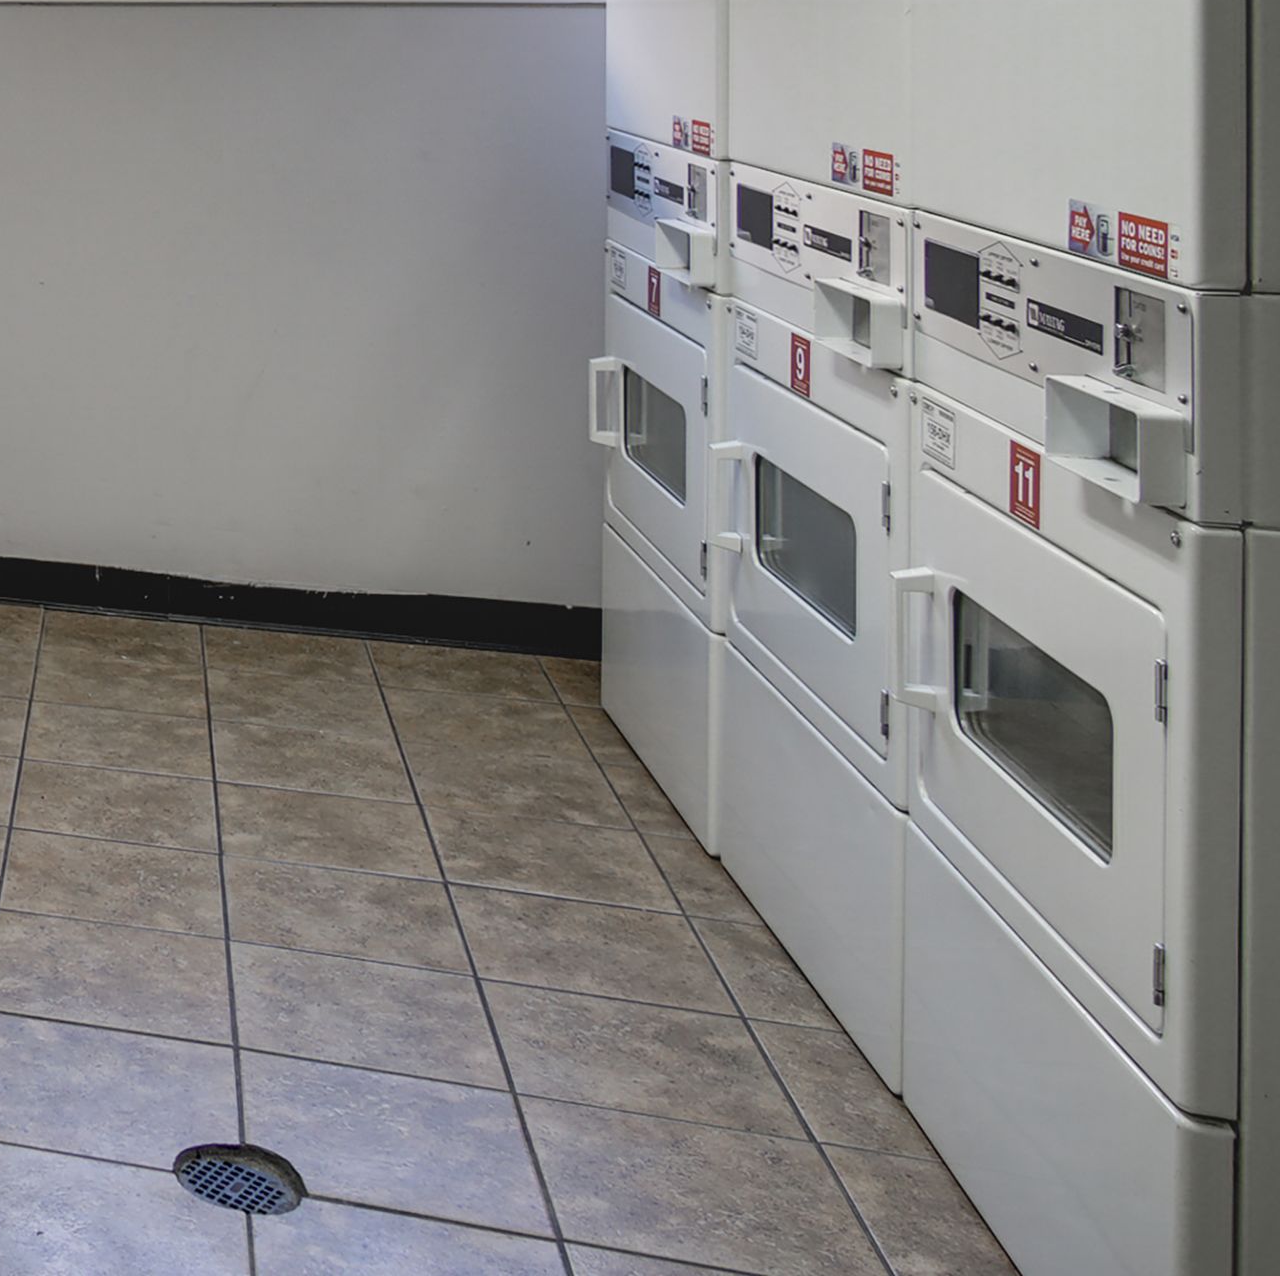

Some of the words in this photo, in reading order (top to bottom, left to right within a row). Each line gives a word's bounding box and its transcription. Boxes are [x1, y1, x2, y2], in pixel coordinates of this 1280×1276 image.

[1071, 224, 1091, 242] HERE
[1074, 214, 1087, 228] PAY
[1120, 218, 1136, 238] NO
[1138, 223, 1165, 245] NEED
[1120, 235, 1136, 252] FOR
[1137, 240, 1165, 260] COINS!
[650, 277, 658, 303] 7
[795, 346, 805, 381] 9
[1014, 460, 1035, 508] 11
